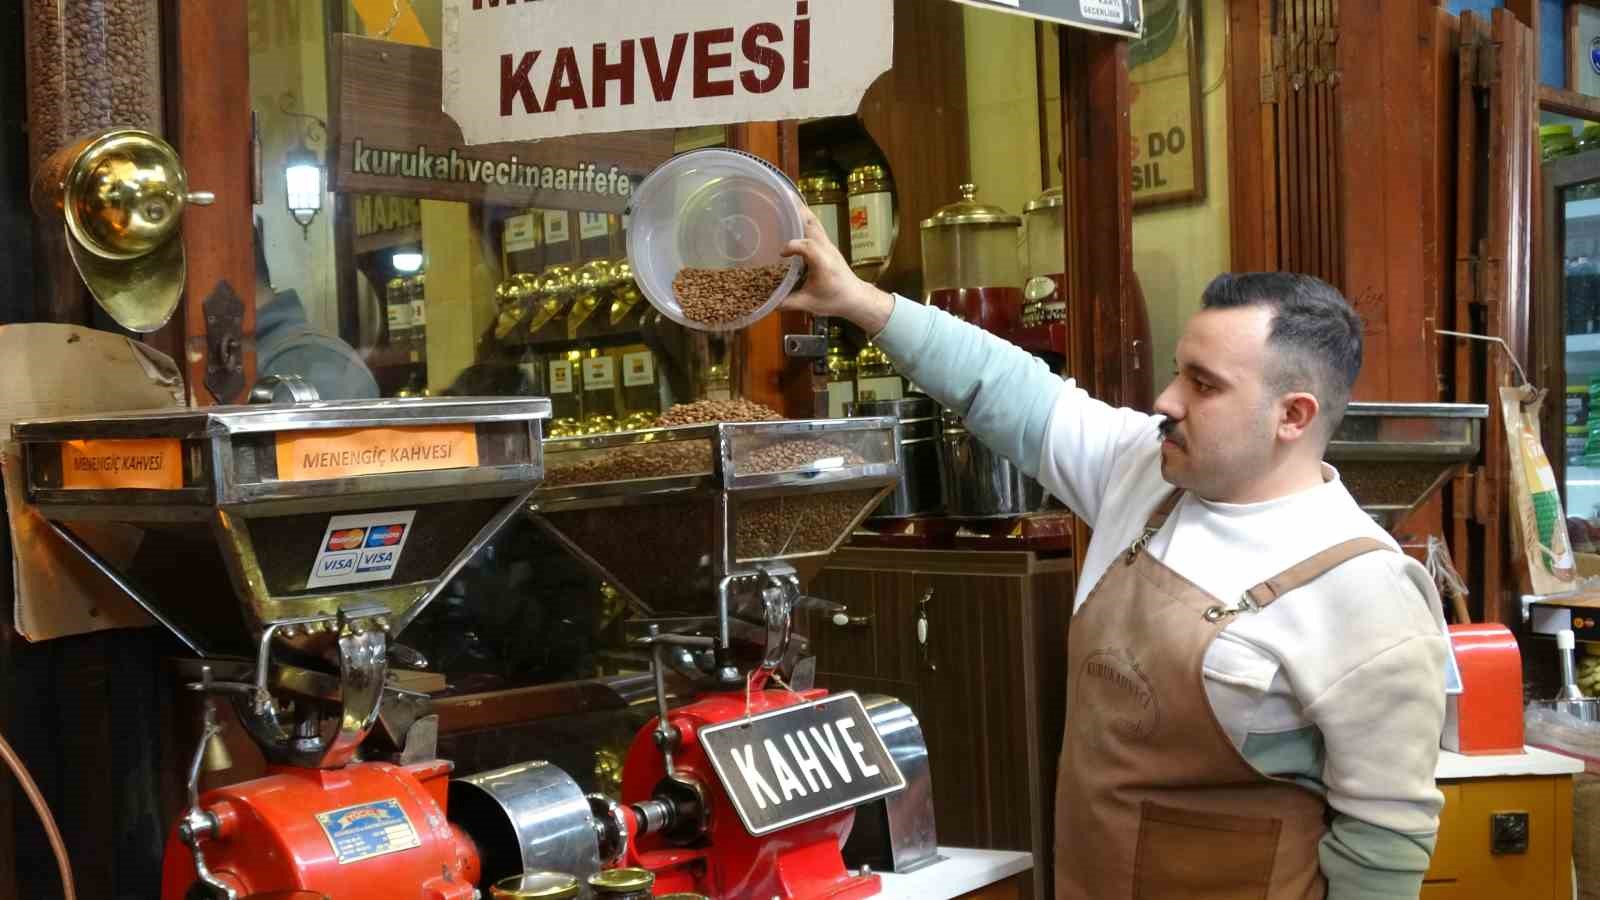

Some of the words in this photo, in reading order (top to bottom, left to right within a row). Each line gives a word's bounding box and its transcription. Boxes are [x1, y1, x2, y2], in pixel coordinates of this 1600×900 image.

[500, 0, 811, 117] KAHVESİ
[1148, 126, 1185, 157] DO
[122, 452, 163, 472] KAHVESİ
[303, 446, 387, 469] MENENGİÇ
[390, 442, 453, 463] KAHVESİ
[325, 558, 354, 572] VISA
[365, 551, 393, 565] VISA
[730, 717, 881, 809] KAHVE
